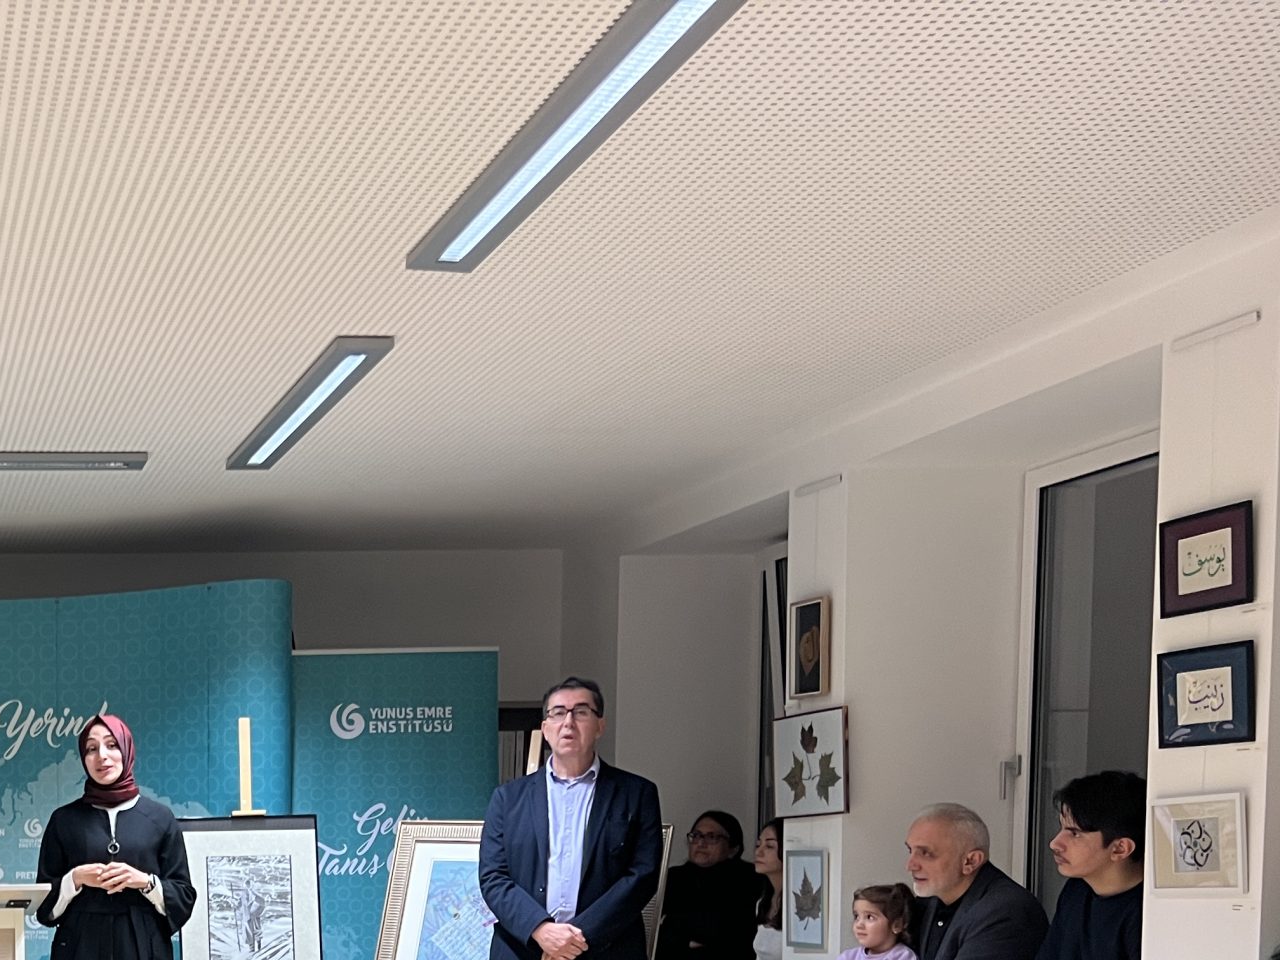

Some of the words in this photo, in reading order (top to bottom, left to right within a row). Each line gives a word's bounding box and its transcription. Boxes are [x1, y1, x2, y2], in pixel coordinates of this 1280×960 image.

[369, 707, 414, 719] YUNUS
[416, 706, 453, 718] EMRE
[369, 720, 453, 734] ENSTİTÜSÜ
[352, 803, 429, 856] Gel
